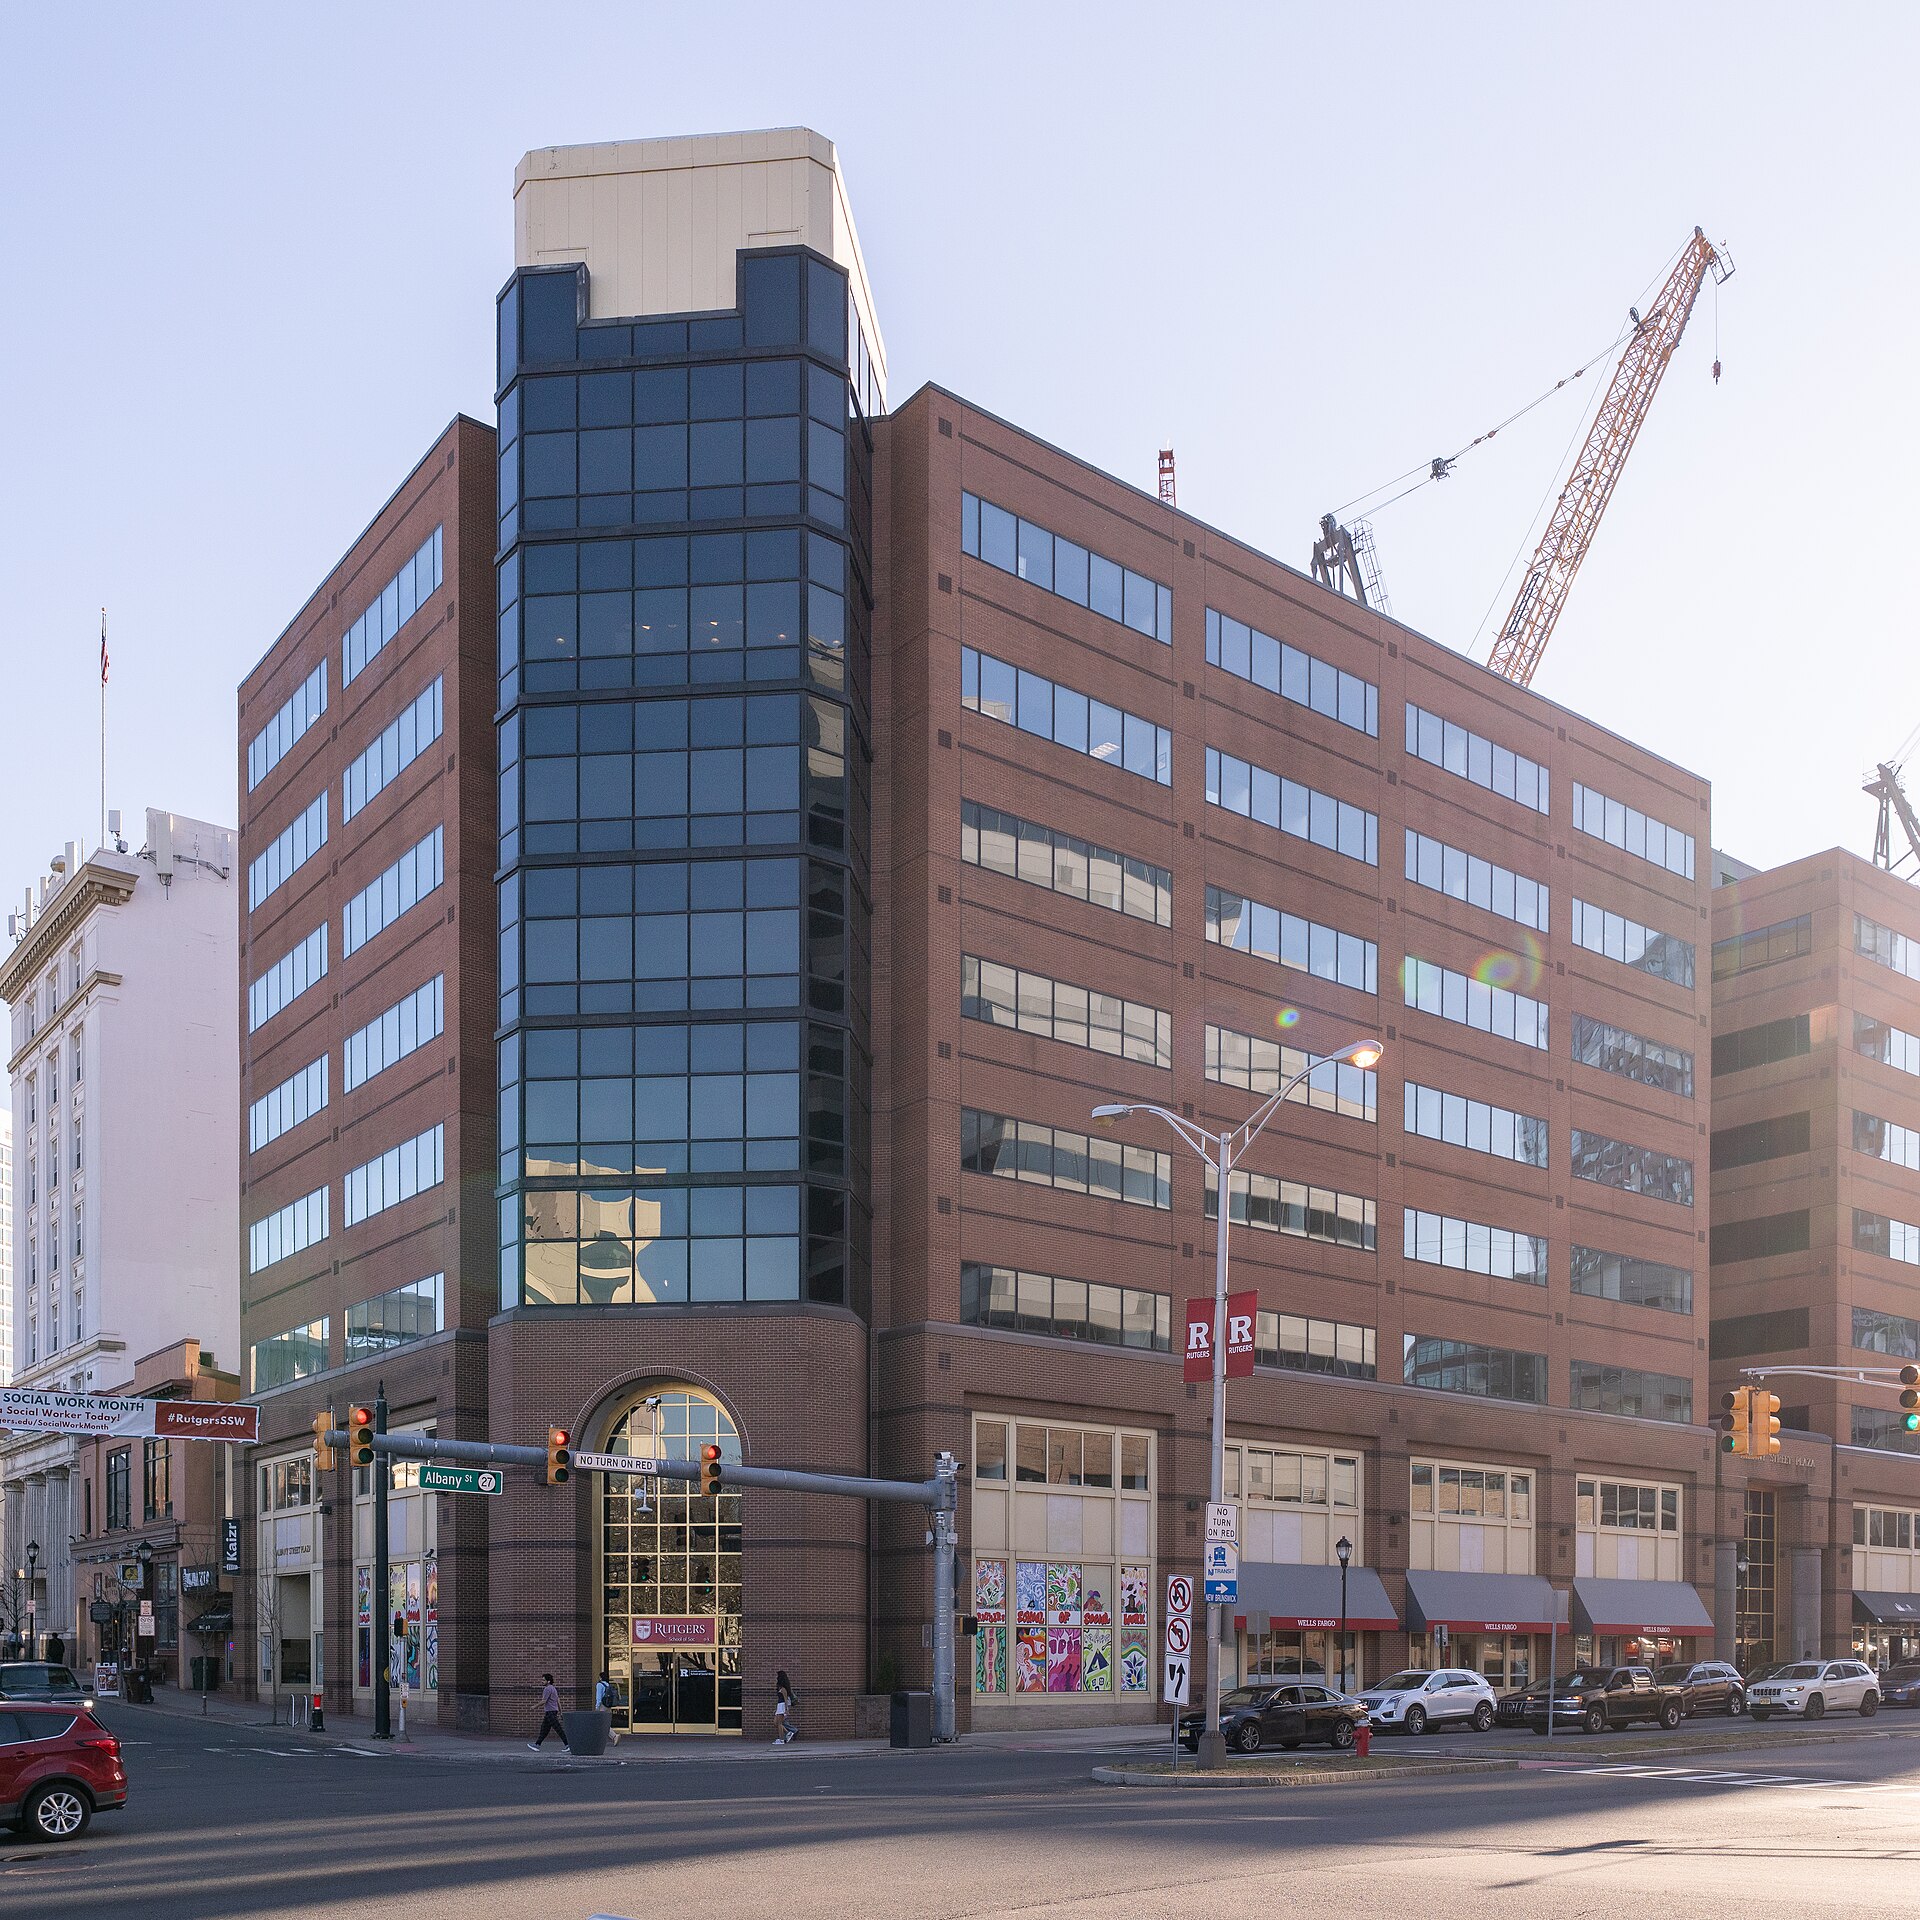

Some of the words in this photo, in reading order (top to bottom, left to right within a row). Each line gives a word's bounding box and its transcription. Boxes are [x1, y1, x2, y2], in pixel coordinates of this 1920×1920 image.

[1188, 1322, 1209, 1350] R
[1229, 1316, 1253, 1344] R
[1186, 1350, 1210, 1359] RUTGERS
[1228, 1344, 1253, 1354] RUTGERS
[3, 1392, 51, 1405] SOCIAL
[55, 1396, 95, 1409] WORK
[98, 1400, 144, 1411] MONTH
[6, 1406, 38, 1416] Social
[42, 1408, 82, 1419] Worker
[85, 1411, 120, 1423] Today!
[168, 1413, 245, 1426] #RutgersSSW
[0, 1418, 109, 1430] ers.edu/SocialWorkMonth
[580, 1455, 593, 1465] NO
[595, 1457, 618, 1468] TURN
[621, 1459, 633, 1469] ON
[635, 1460, 653, 1470] RED
[425, 1471, 462, 1489] Albany
[464, 1474, 473, 1483] St
[481, 1476, 493, 1487] 27
[1216, 1508, 1228, 1516] NO
[1213, 1517, 1231, 1527] TURN
[1208, 1528, 1218, 1536] ON
[1221, 1529, 1235, 1538] RED
[226, 1522, 238, 1561] Kaizr
[1215, 1594, 1237, 1602] BRUNSWICK
[1058, 1611, 1071, 1624] OF
[1297, 1619, 1317, 1627] WELLS
[1317, 1619, 1336, 1627] FARGO
[655, 1622, 706, 1638] RUTGERS
[1484, 1623, 1501, 1631] WELLS
[1501, 1623, 1518, 1631] FARGO
[680, 1668, 689, 1677] R
